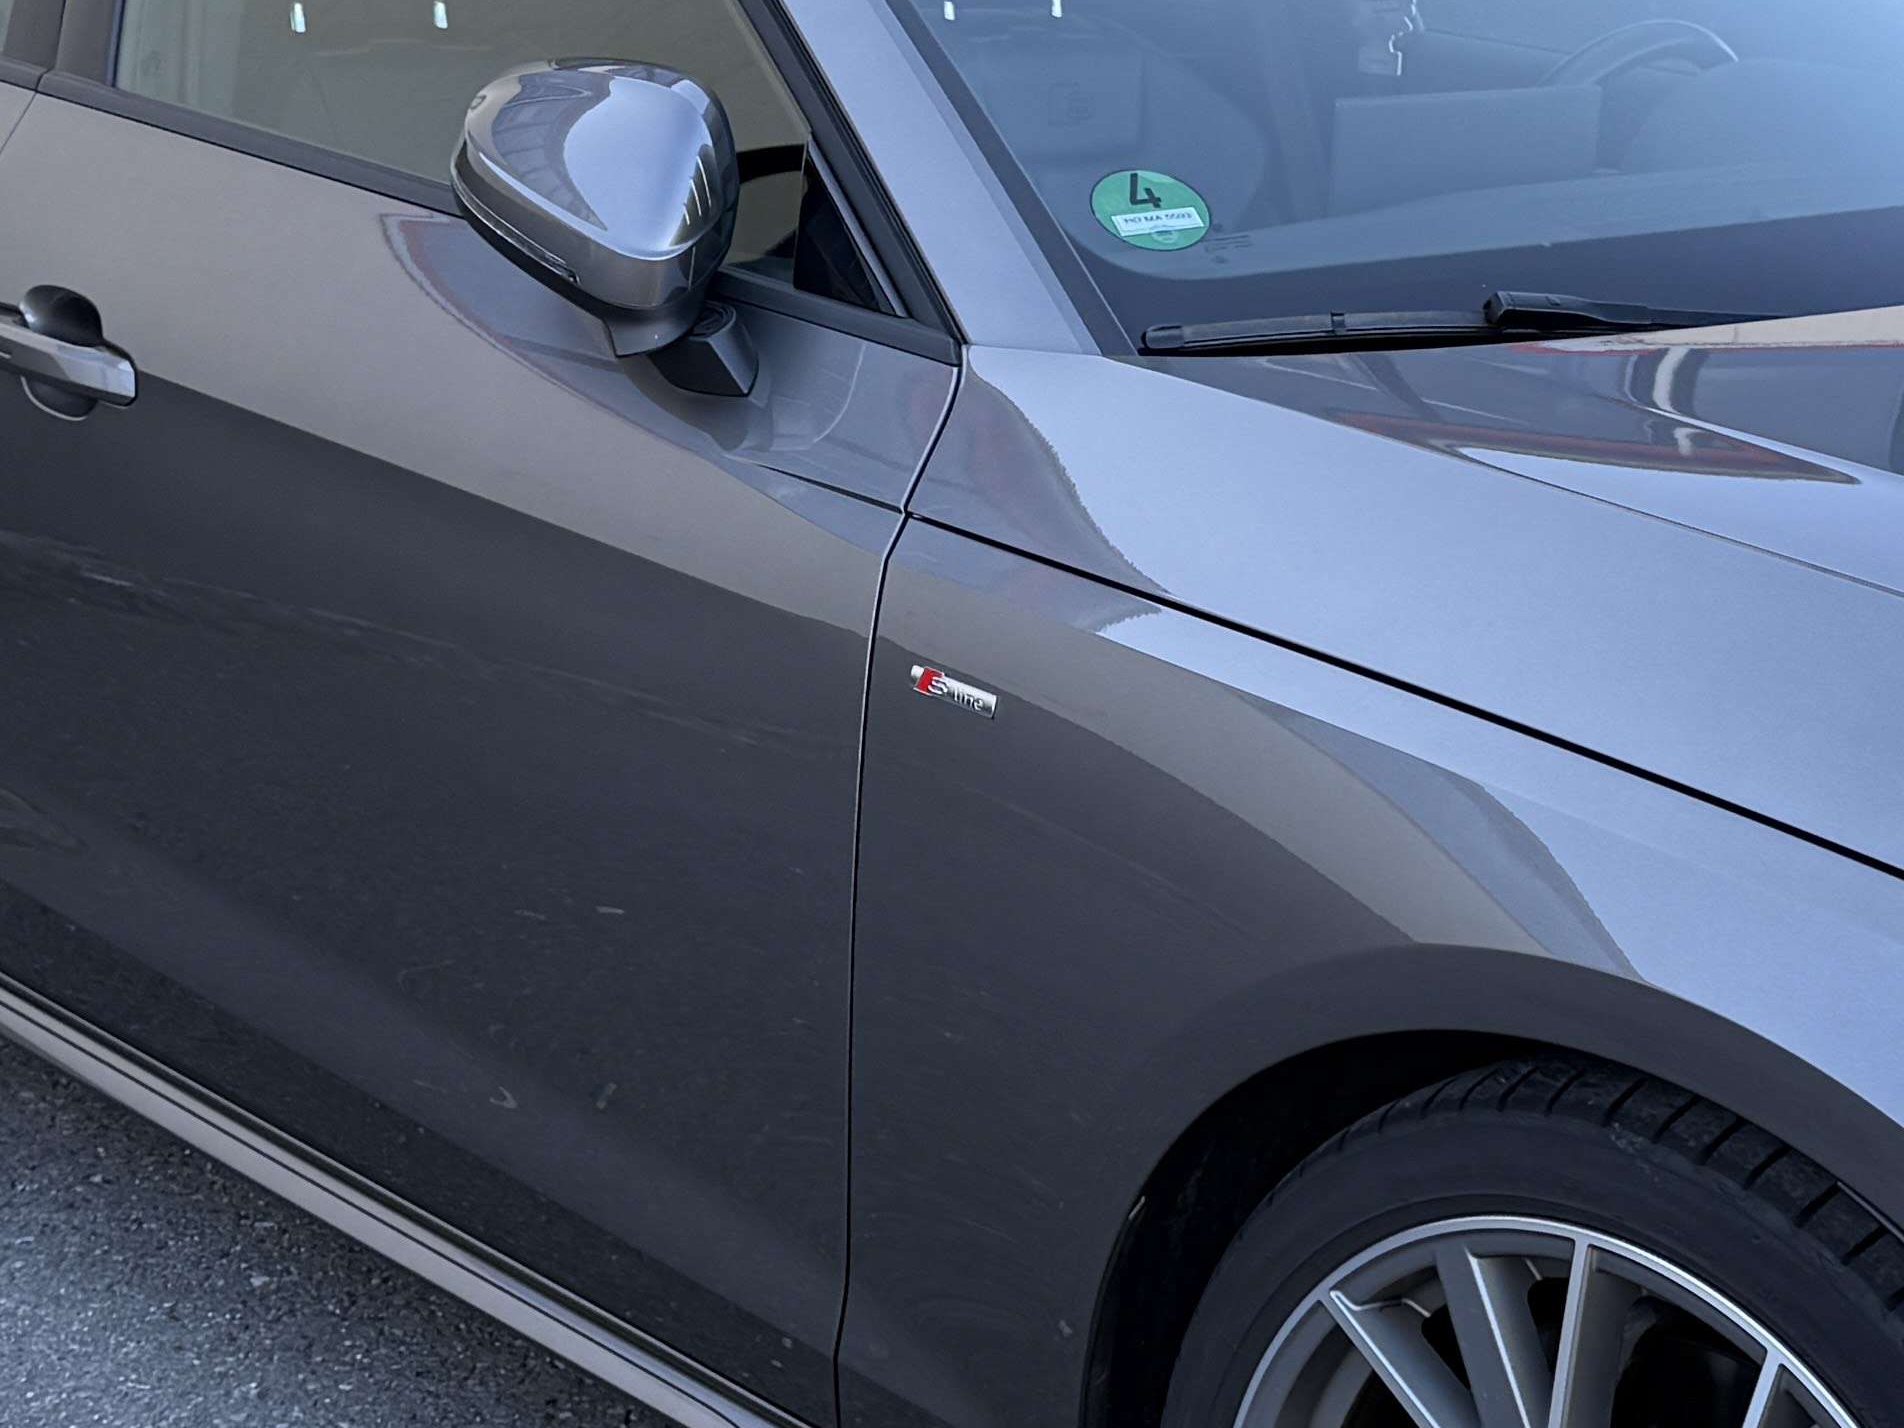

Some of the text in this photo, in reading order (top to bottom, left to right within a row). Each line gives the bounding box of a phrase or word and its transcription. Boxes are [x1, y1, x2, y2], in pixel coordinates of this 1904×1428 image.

[1129, 172, 1161, 208] 4
[927, 676, 984, 711] S line
